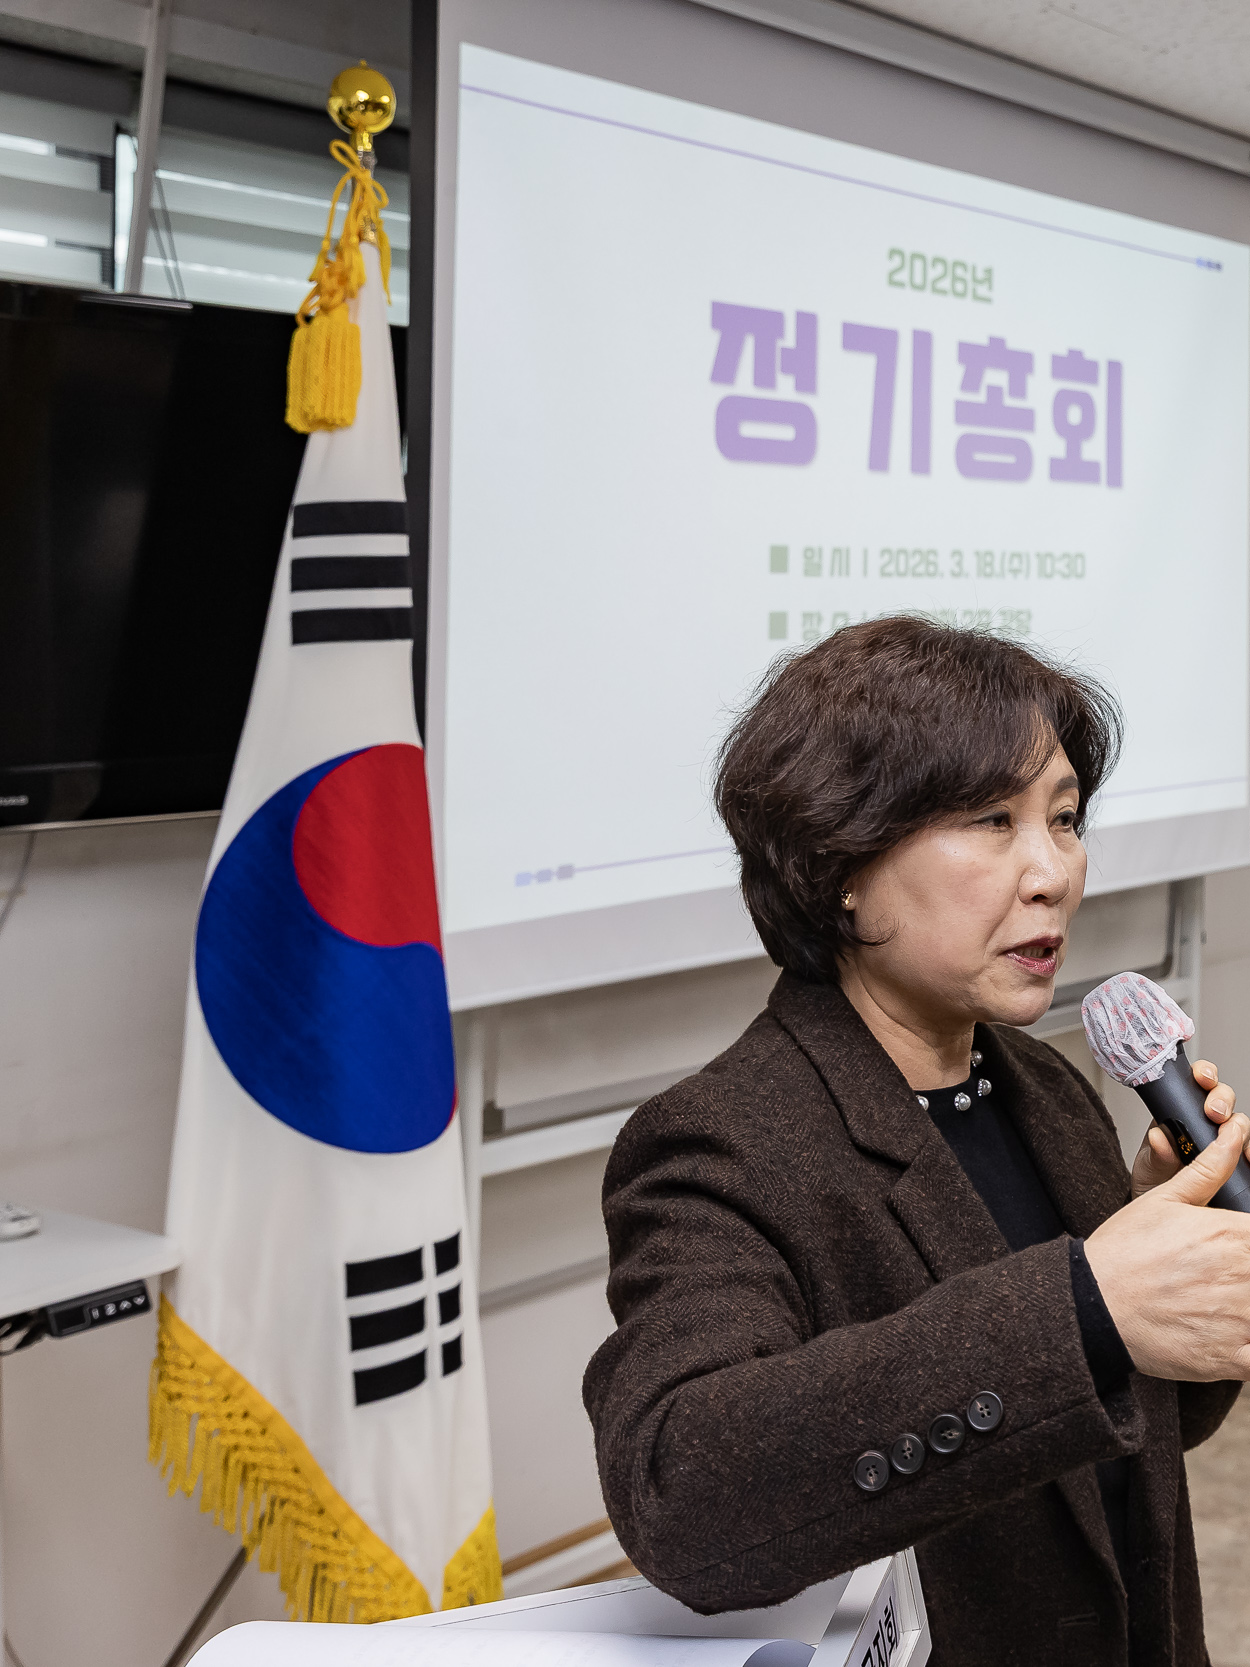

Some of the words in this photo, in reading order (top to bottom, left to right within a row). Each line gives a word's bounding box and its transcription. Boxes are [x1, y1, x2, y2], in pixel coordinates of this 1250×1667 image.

[886, 247, 993, 303] 2026년
[710, 300, 1123, 489] 정기총회
[879, 549, 944, 579] 2026.
